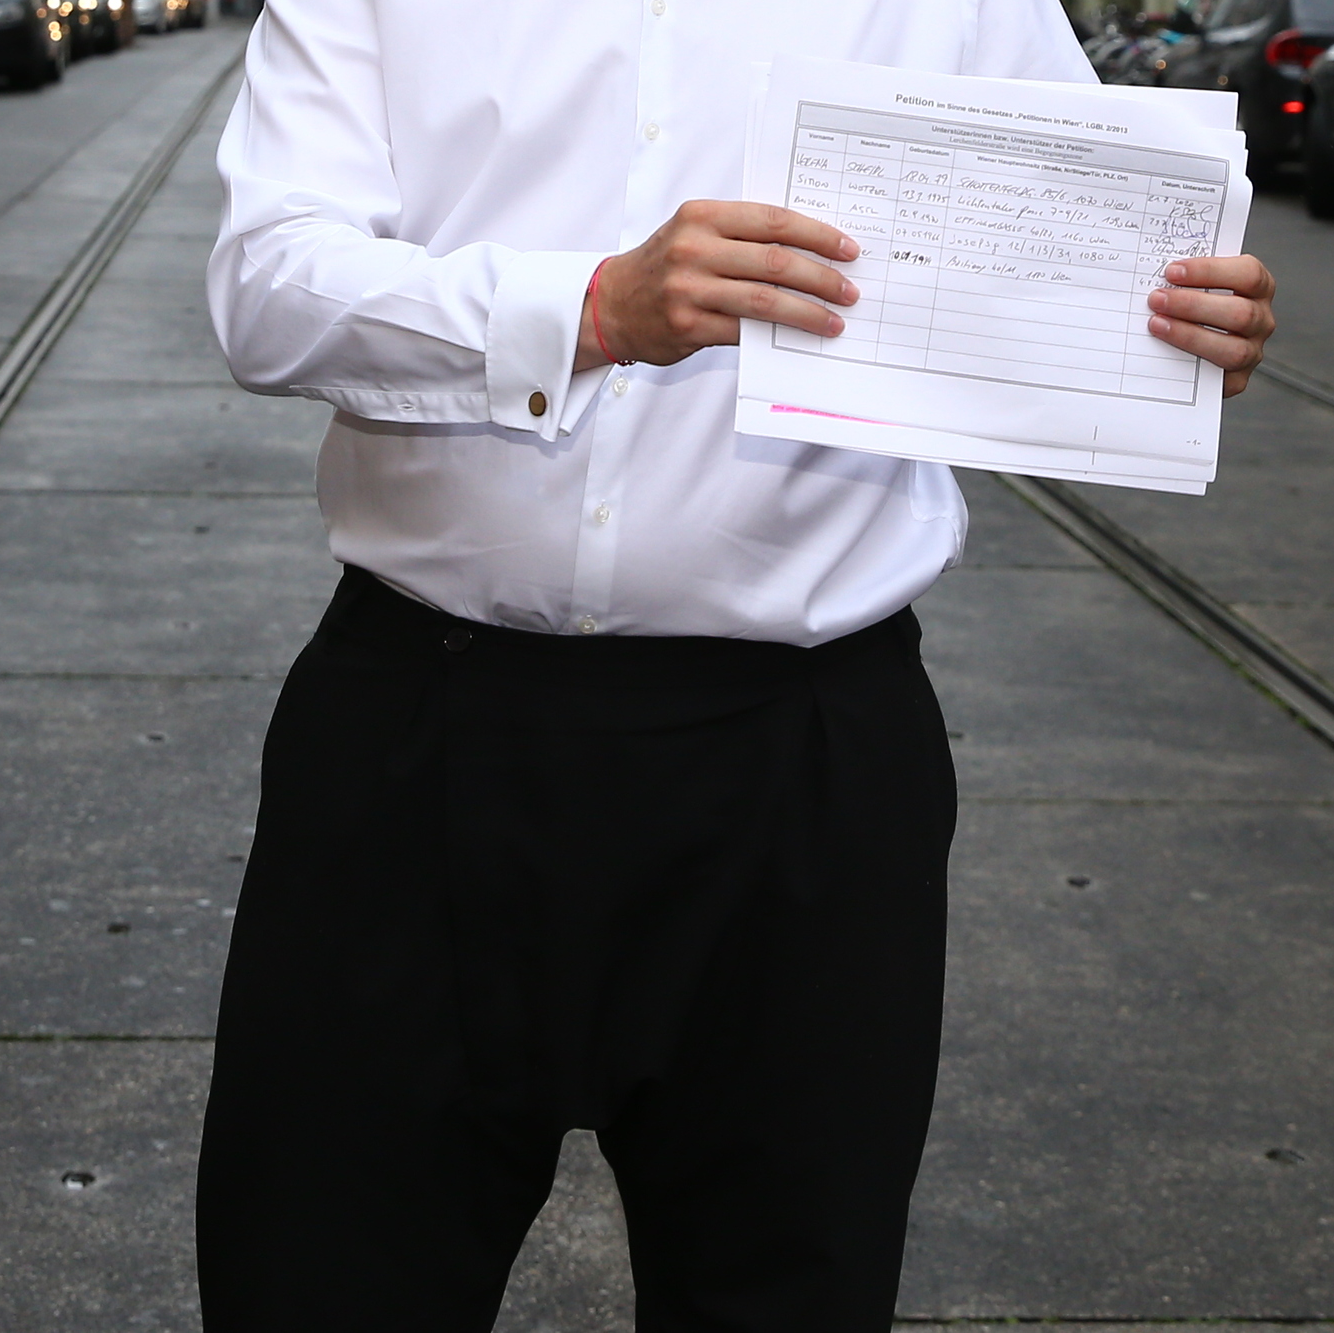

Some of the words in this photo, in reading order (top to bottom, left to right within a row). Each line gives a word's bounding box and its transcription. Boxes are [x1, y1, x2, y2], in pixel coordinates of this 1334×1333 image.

[895, 93, 935, 108] Petition
[946, 103, 967, 112] Sinne
[967, 106, 981, 114] des
[981, 107, 1013, 118] Gesetzes
[1053, 117, 1061, 125] in
[1105, 124, 1128, 134] 2/2013
[808, 132, 835, 142] Vorname
[860, 139, 891, 149] Nachname
[993, 133, 1009, 142] bzw.
[1010, 135, 1053, 148] Unterstützer
[1053, 142, 1066, 150] der
[1066, 143, 1095, 154] Petition:
[908, 145, 950, 157] Geburtsdatum
[977, 155, 998, 163] Wiener
[1182, 183, 1216, 194] Unterschrift
[1079, 251, 1105, 262] 1080
